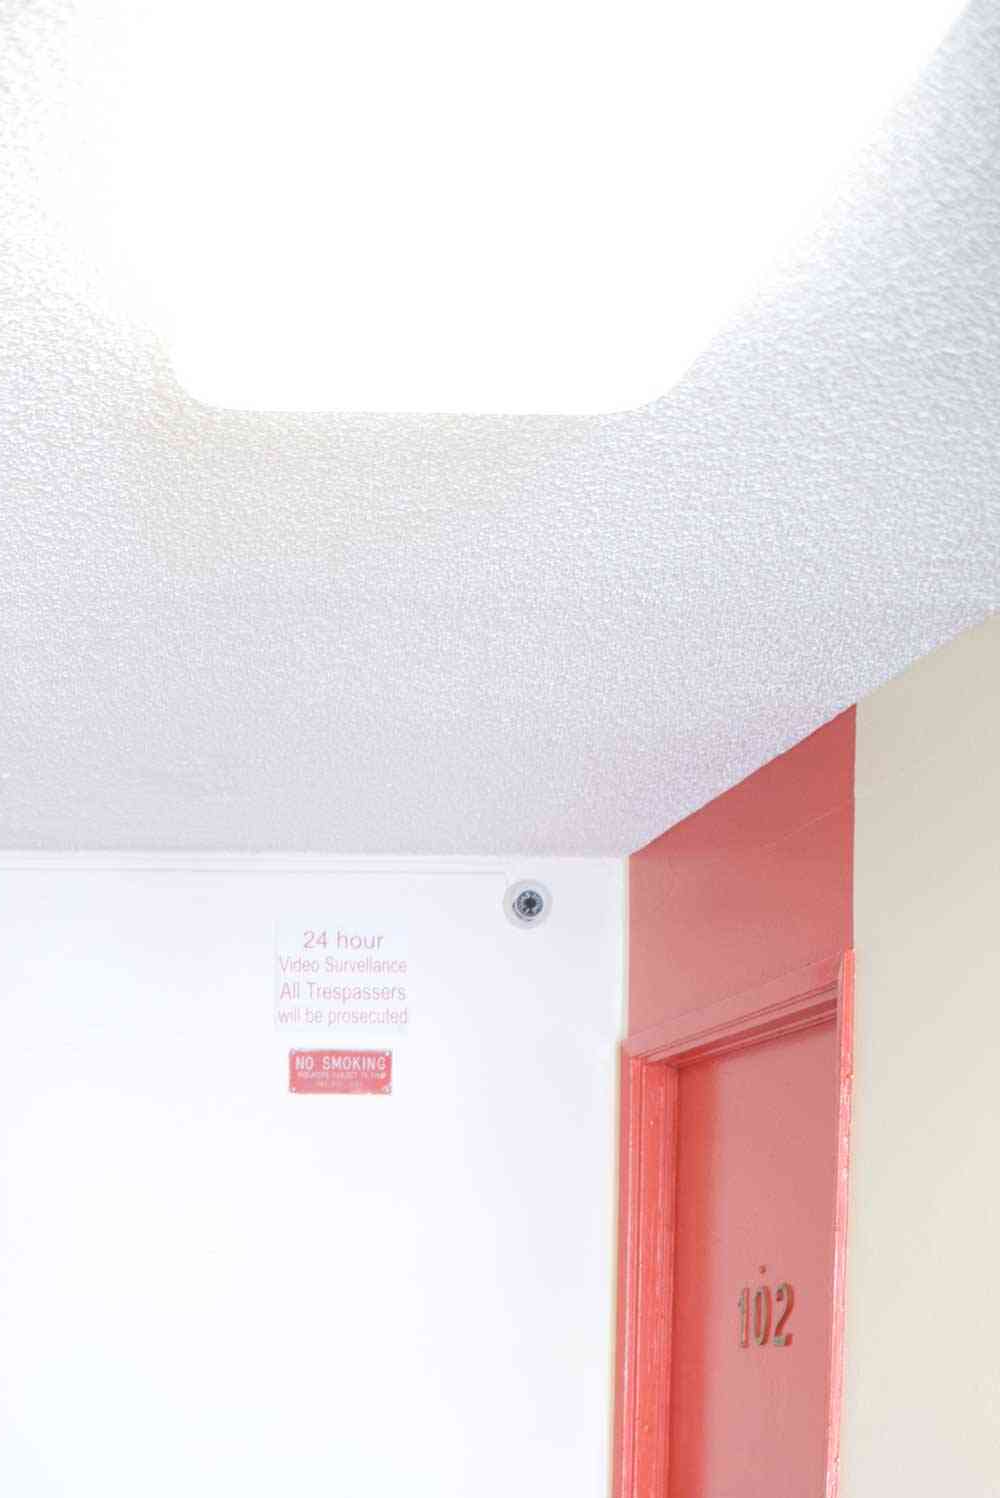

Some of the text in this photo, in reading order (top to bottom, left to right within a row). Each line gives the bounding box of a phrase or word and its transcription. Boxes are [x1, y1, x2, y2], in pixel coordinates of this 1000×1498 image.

[303, 930, 384, 950] 24 hour
[279, 955, 320, 973] Video
[280, 981, 406, 1005] All Trespassers
[278, 1007, 408, 1028] will be prosecuted
[295, 1056, 386, 1070] NO SMOKING
[738, 1282, 794, 1348] 102
